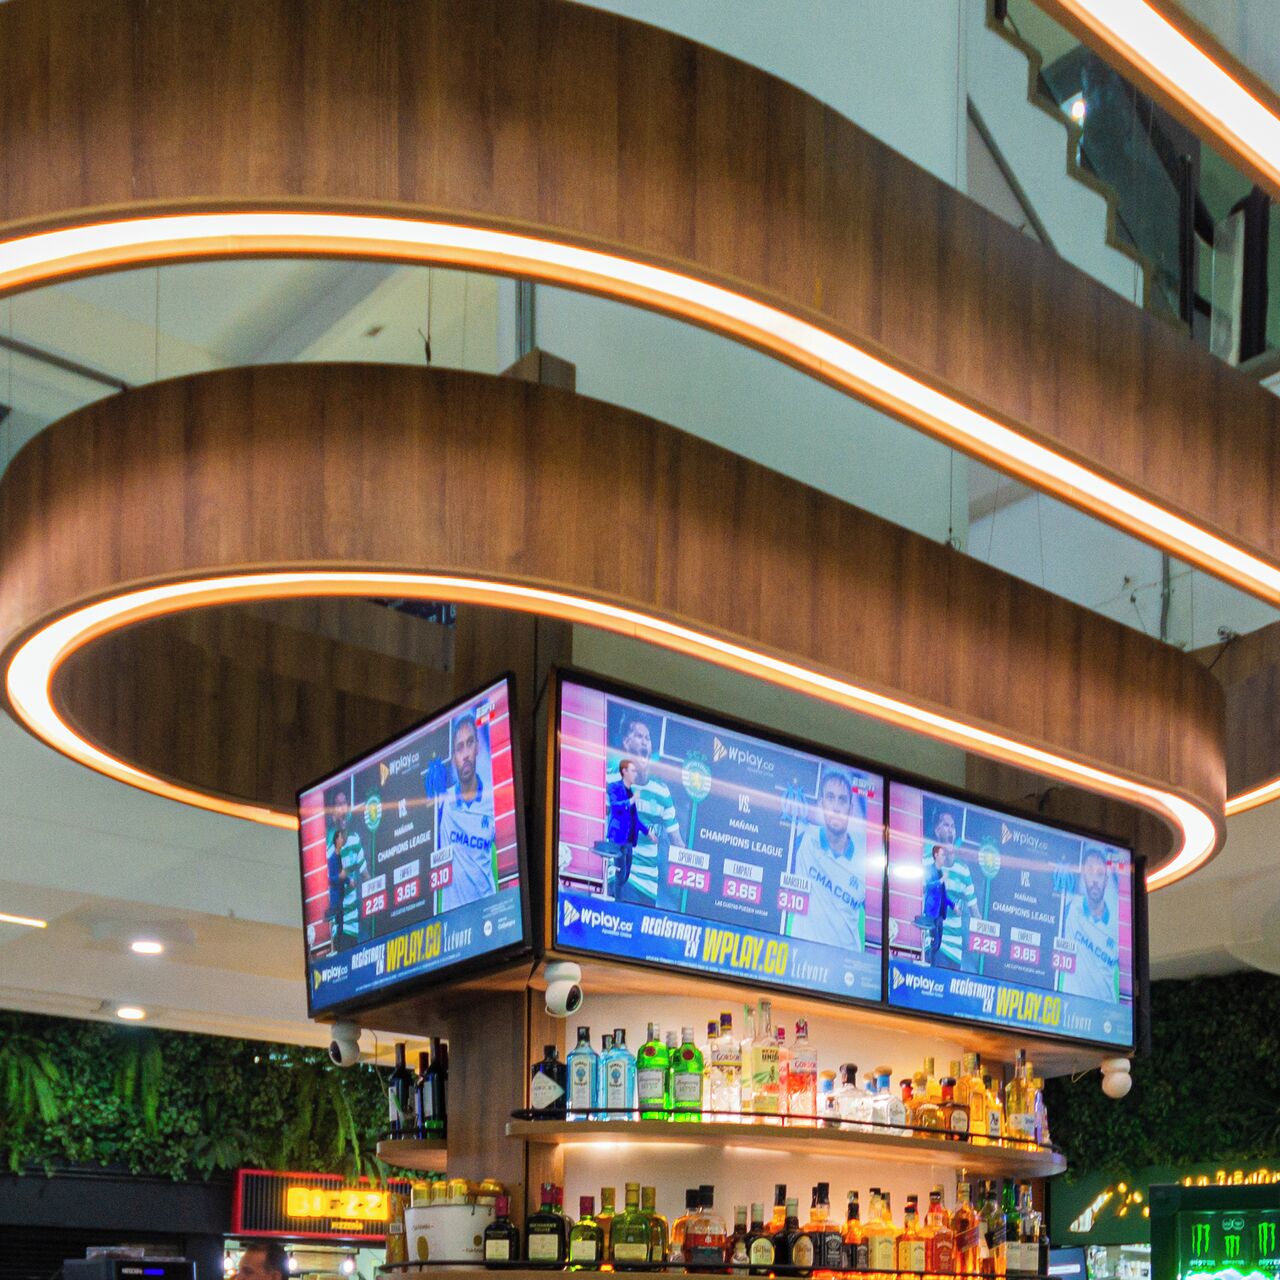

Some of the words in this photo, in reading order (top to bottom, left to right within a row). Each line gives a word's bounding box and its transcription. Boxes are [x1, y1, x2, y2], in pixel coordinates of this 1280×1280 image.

[729, 817, 759, 833] MAÑANA
[378, 841, 408, 863] CHAMPIONS
[409, 830, 431, 849] LEAGUE
[700, 828, 750, 850] CHAMPIONS
[751, 842, 784, 858] LEAGUE
[431, 870, 449, 888] 3.10
[673, 868, 705, 889] 2.25
[809, 866, 833, 891] CMA
[397, 884, 417, 902] 3.65
[727, 880, 757, 900] 3.65
[365, 895, 385, 914] 2.25
[778, 892, 804, 911] 3.10
[992, 902, 1030, 919] CHAMPIONS
[1031, 911, 1056, 924] LEAGUE
[641, 915, 702, 943] REGÍSTRATE
[386, 921, 441, 972] WPLAY.CO
[684, 940, 697, 957] EN
[704, 927, 788, 975] WPLAY.CO
[972, 937, 997, 954] 2.25
[1052, 953, 1072, 970] 3.10
[996, 986, 1061, 1025] WPLAY.CO
